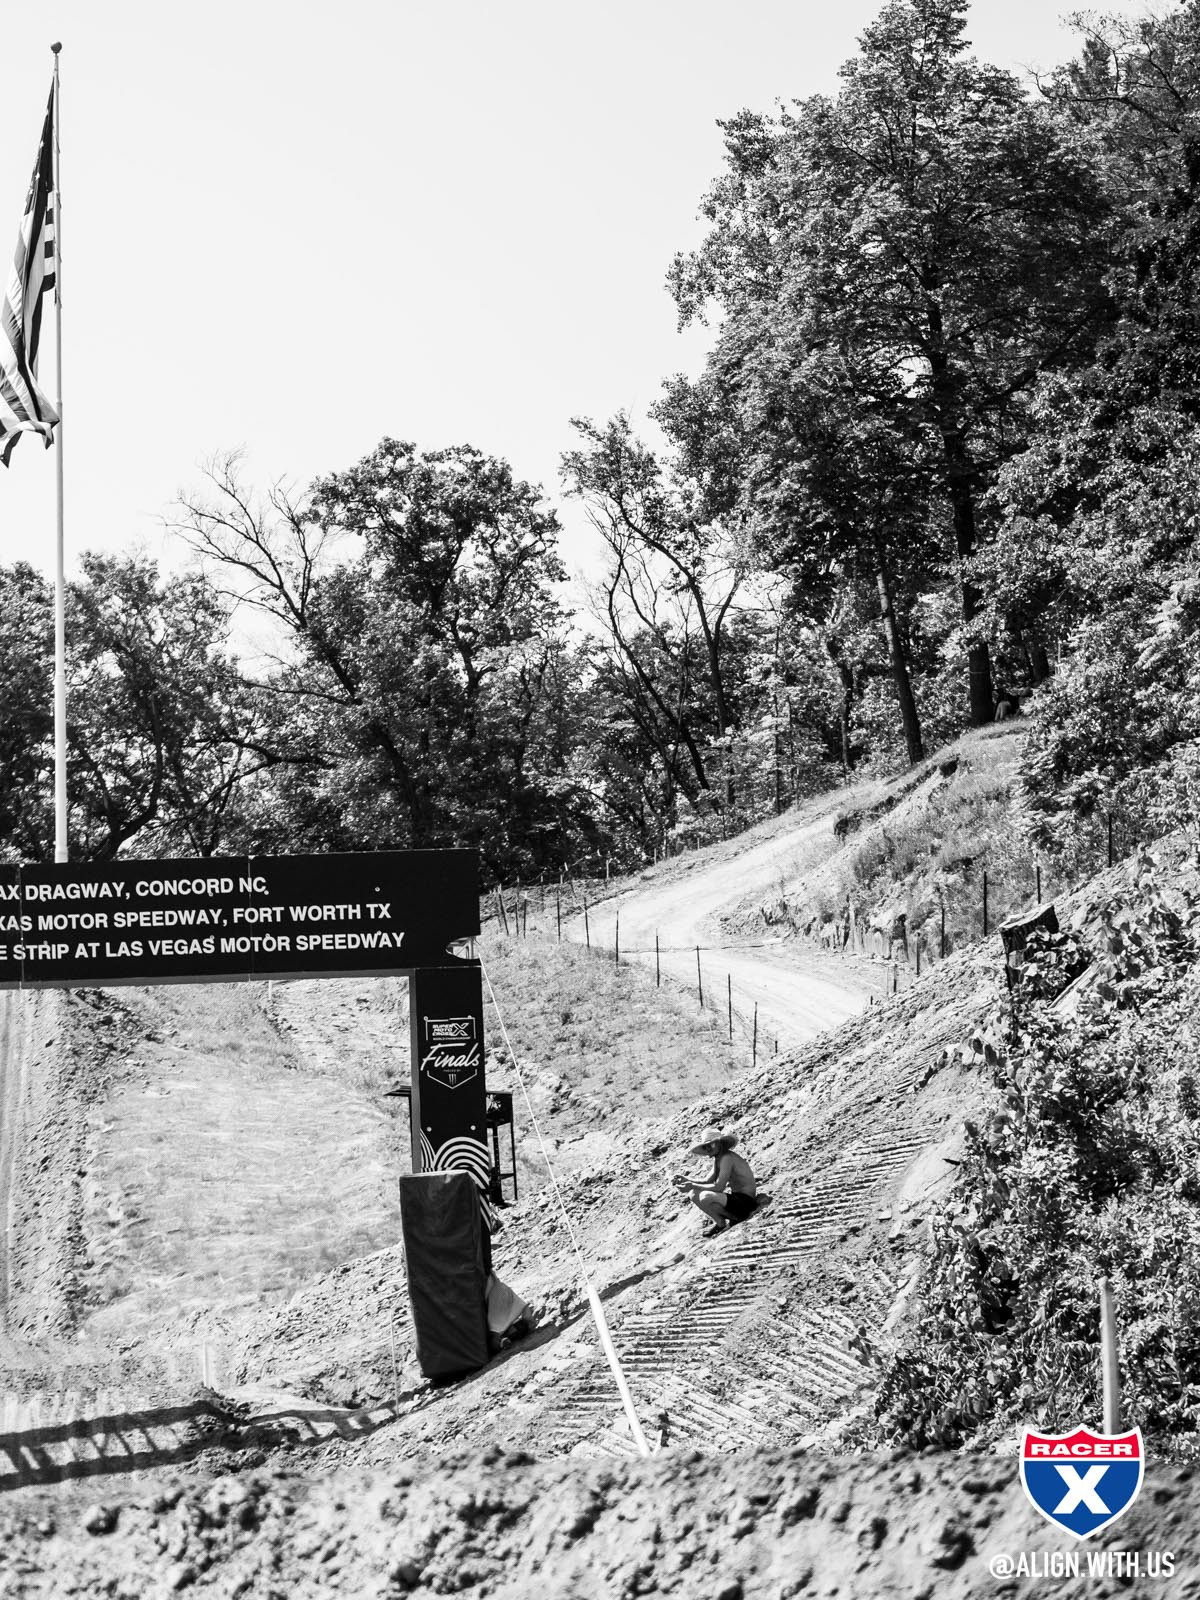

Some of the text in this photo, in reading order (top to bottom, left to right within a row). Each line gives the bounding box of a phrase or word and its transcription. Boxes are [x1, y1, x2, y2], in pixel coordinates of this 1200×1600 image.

[25, 881, 131, 900] DRAGWAY,
[135, 878, 234, 897] CONCORD
[38, 913, 108, 931] MOTOR
[113, 908, 228, 928] SPEEDWAY,
[233, 906, 284, 923] FORT
[289, 904, 361, 922] WORTH
[366, 903, 392, 919] TX
[13, 943, 70, 961] STRIP
[74, 942, 100, 958] AT
[105, 940, 144, 957] LAS
[148, 938, 215, 956] VEGAS
[220, 935, 290, 953] MOTOR
[296, 932, 405, 951] SPEEDWAY
[420, 1042, 481, 1071] Finals
